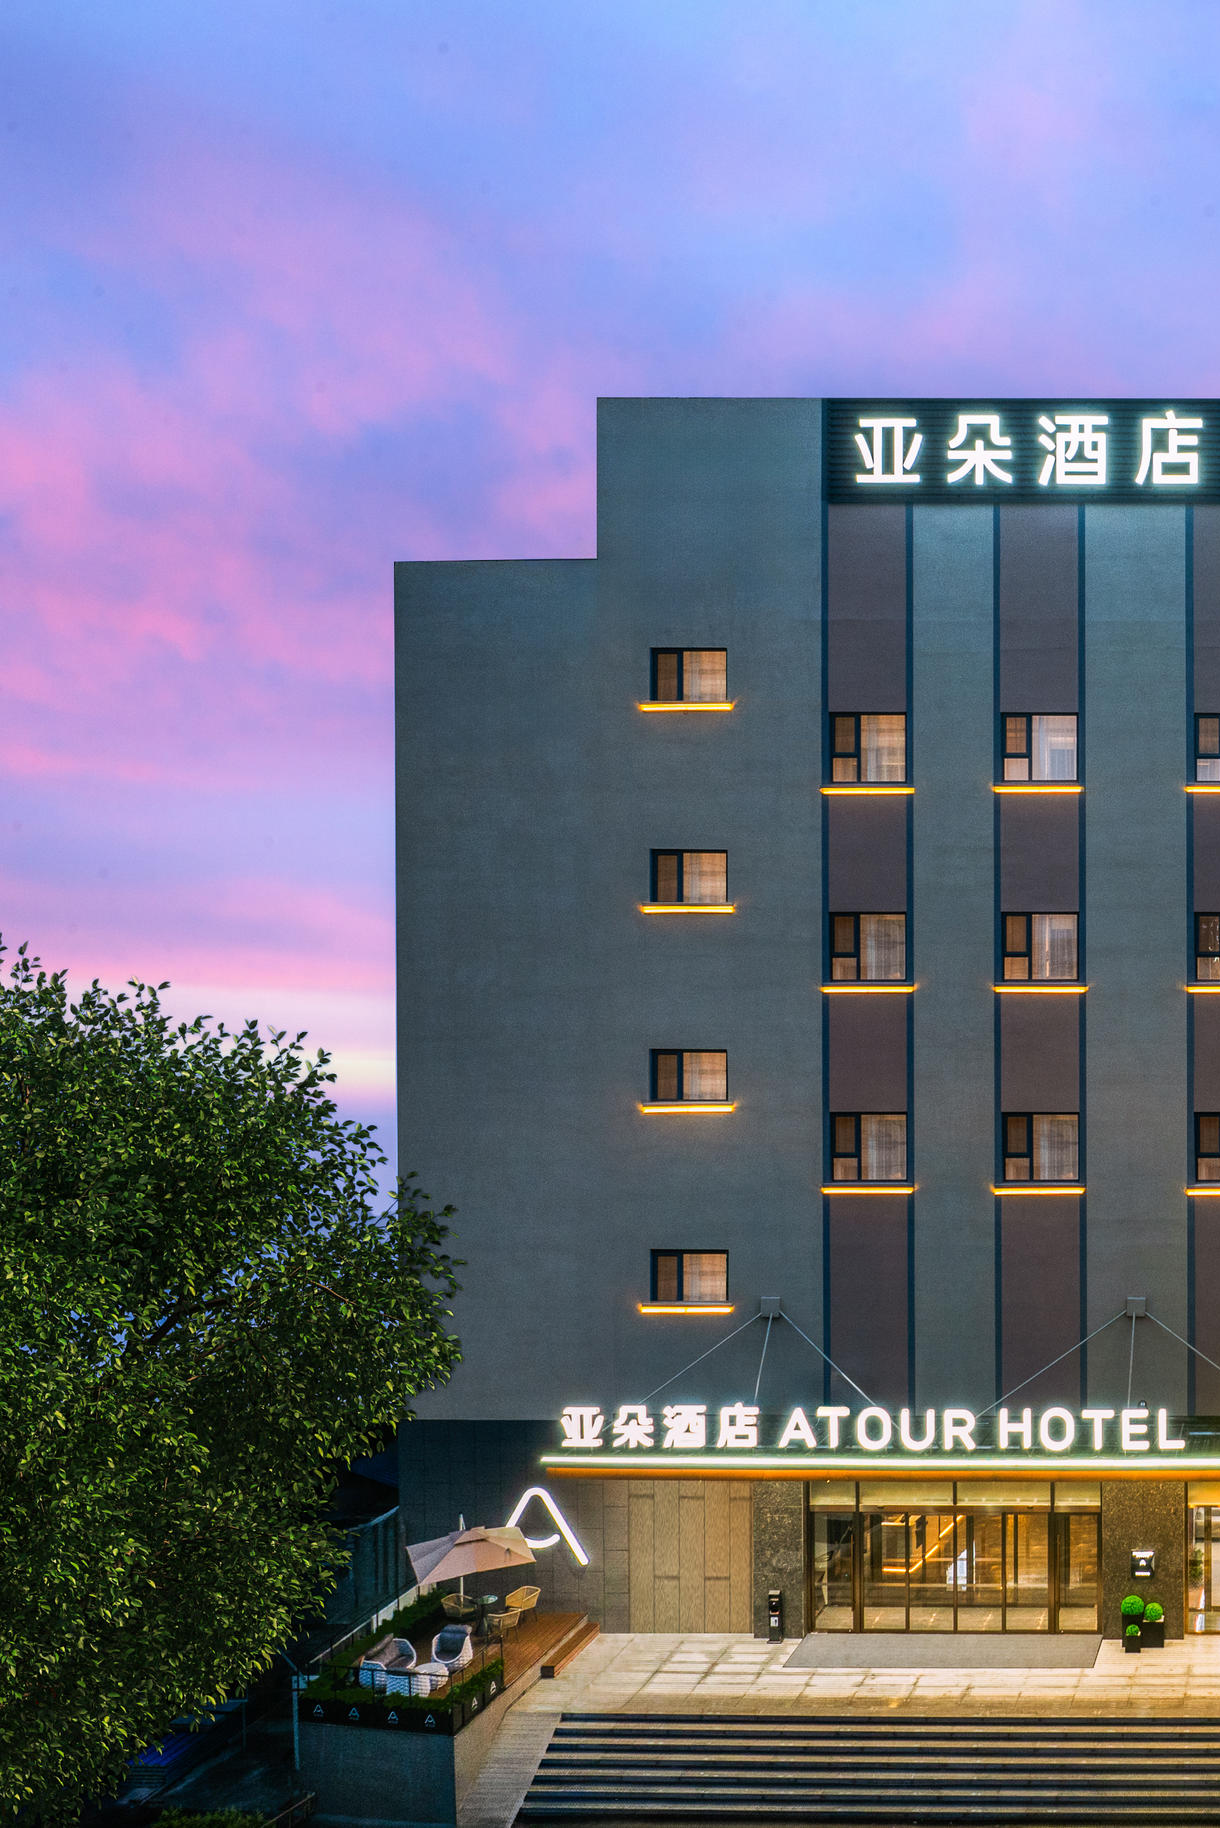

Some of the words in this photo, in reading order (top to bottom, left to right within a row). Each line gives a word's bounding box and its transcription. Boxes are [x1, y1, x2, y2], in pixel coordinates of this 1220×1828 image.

[853, 410, 1203, 486] 亚朵酒店
[559, 1402, 759, 1449] 亚朵酒店
[778, 1406, 977, 1451] ATOUR
[998, 1407, 1187, 1451] HOTEL
